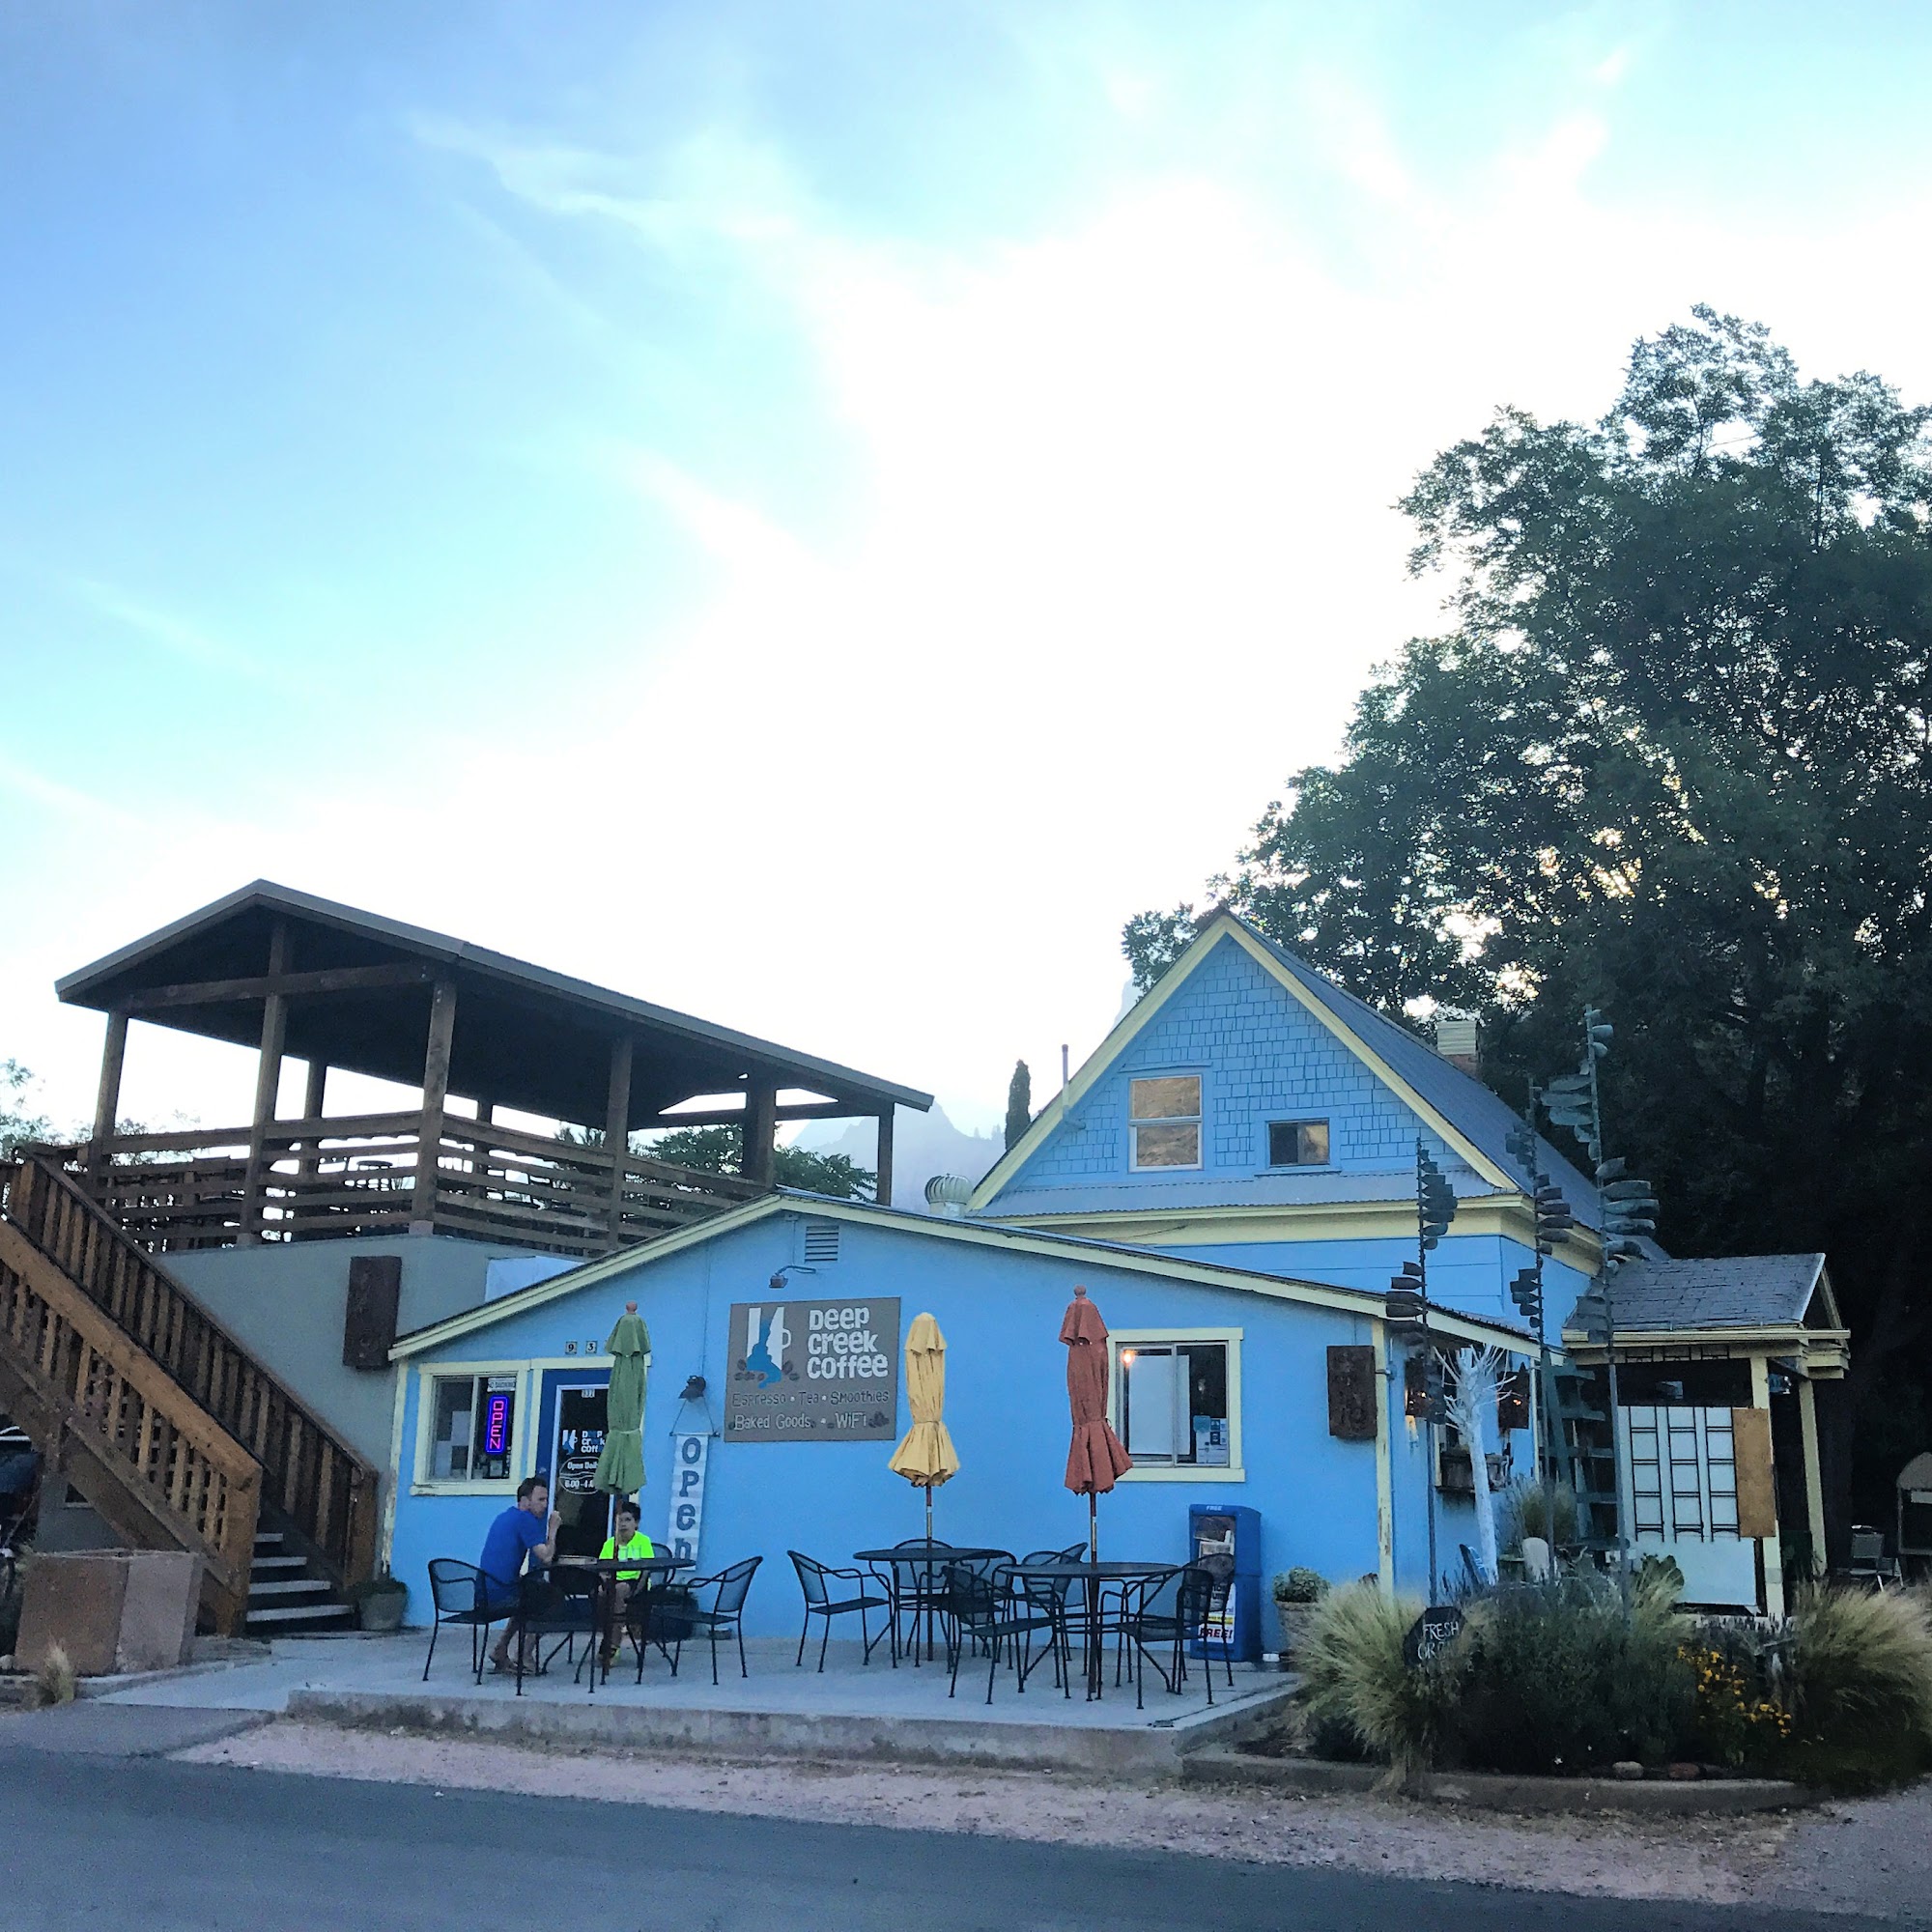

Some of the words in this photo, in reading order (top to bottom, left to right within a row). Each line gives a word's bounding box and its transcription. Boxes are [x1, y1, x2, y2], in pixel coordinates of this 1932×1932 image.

[808, 1330, 879, 1355] Creek
[807, 1353, 889, 1379] Coffee
[732, 1392, 786, 1407] Espresso
[799, 1391, 819, 1406] Tea
[489, 1401, 504, 1450] OPEN
[734, 1414, 770, 1431] Baked
[776, 1412, 811, 1430] Goods
[567, 1462, 583, 1470] Open
[1422, 1621, 1459, 1641] FRESH
